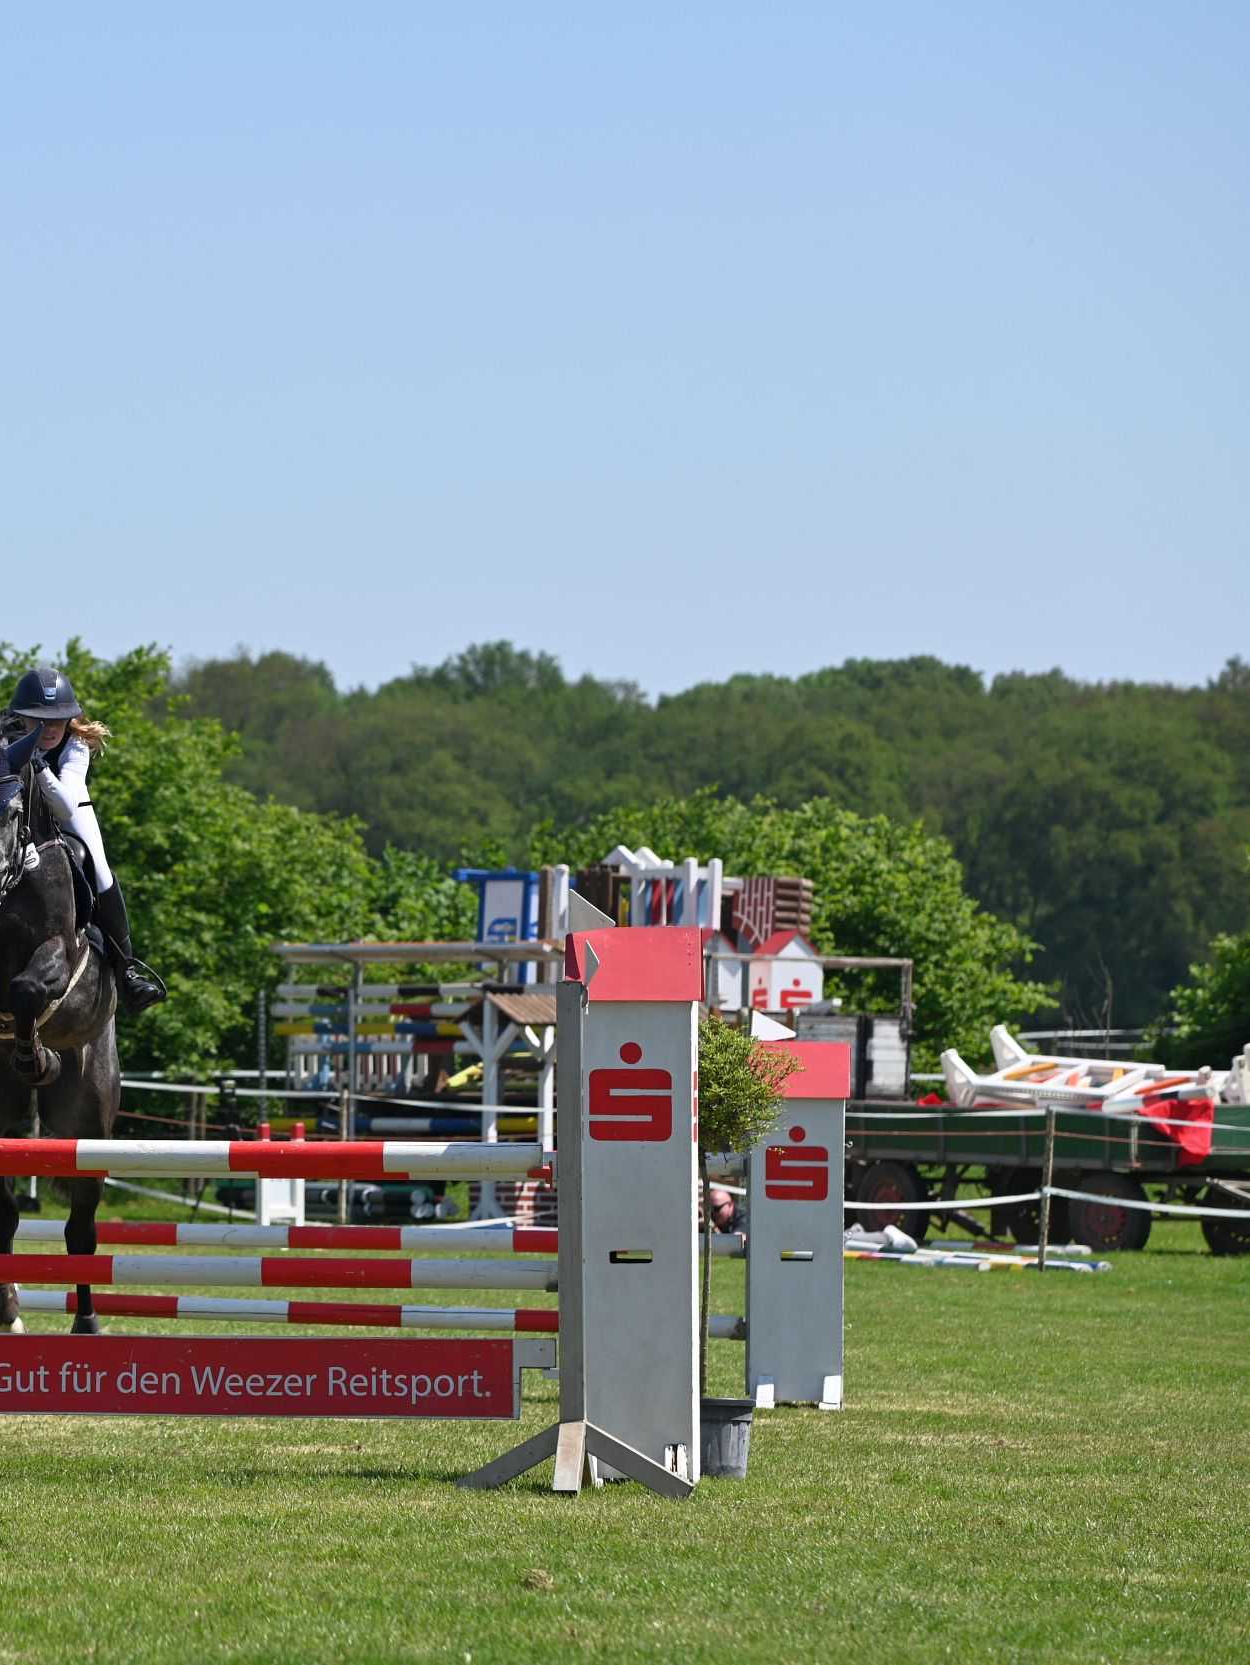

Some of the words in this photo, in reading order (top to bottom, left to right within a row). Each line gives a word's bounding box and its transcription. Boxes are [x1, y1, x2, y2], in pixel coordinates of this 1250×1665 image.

[588, 1068, 673, 1142] S
[765, 1145, 830, 1201] S
[58, 1361, 108, 1394] für
[116, 1362, 181, 1395] den
[190, 1365, 318, 1397] Weezer
[328, 1366, 492, 1405] Reitsport.
